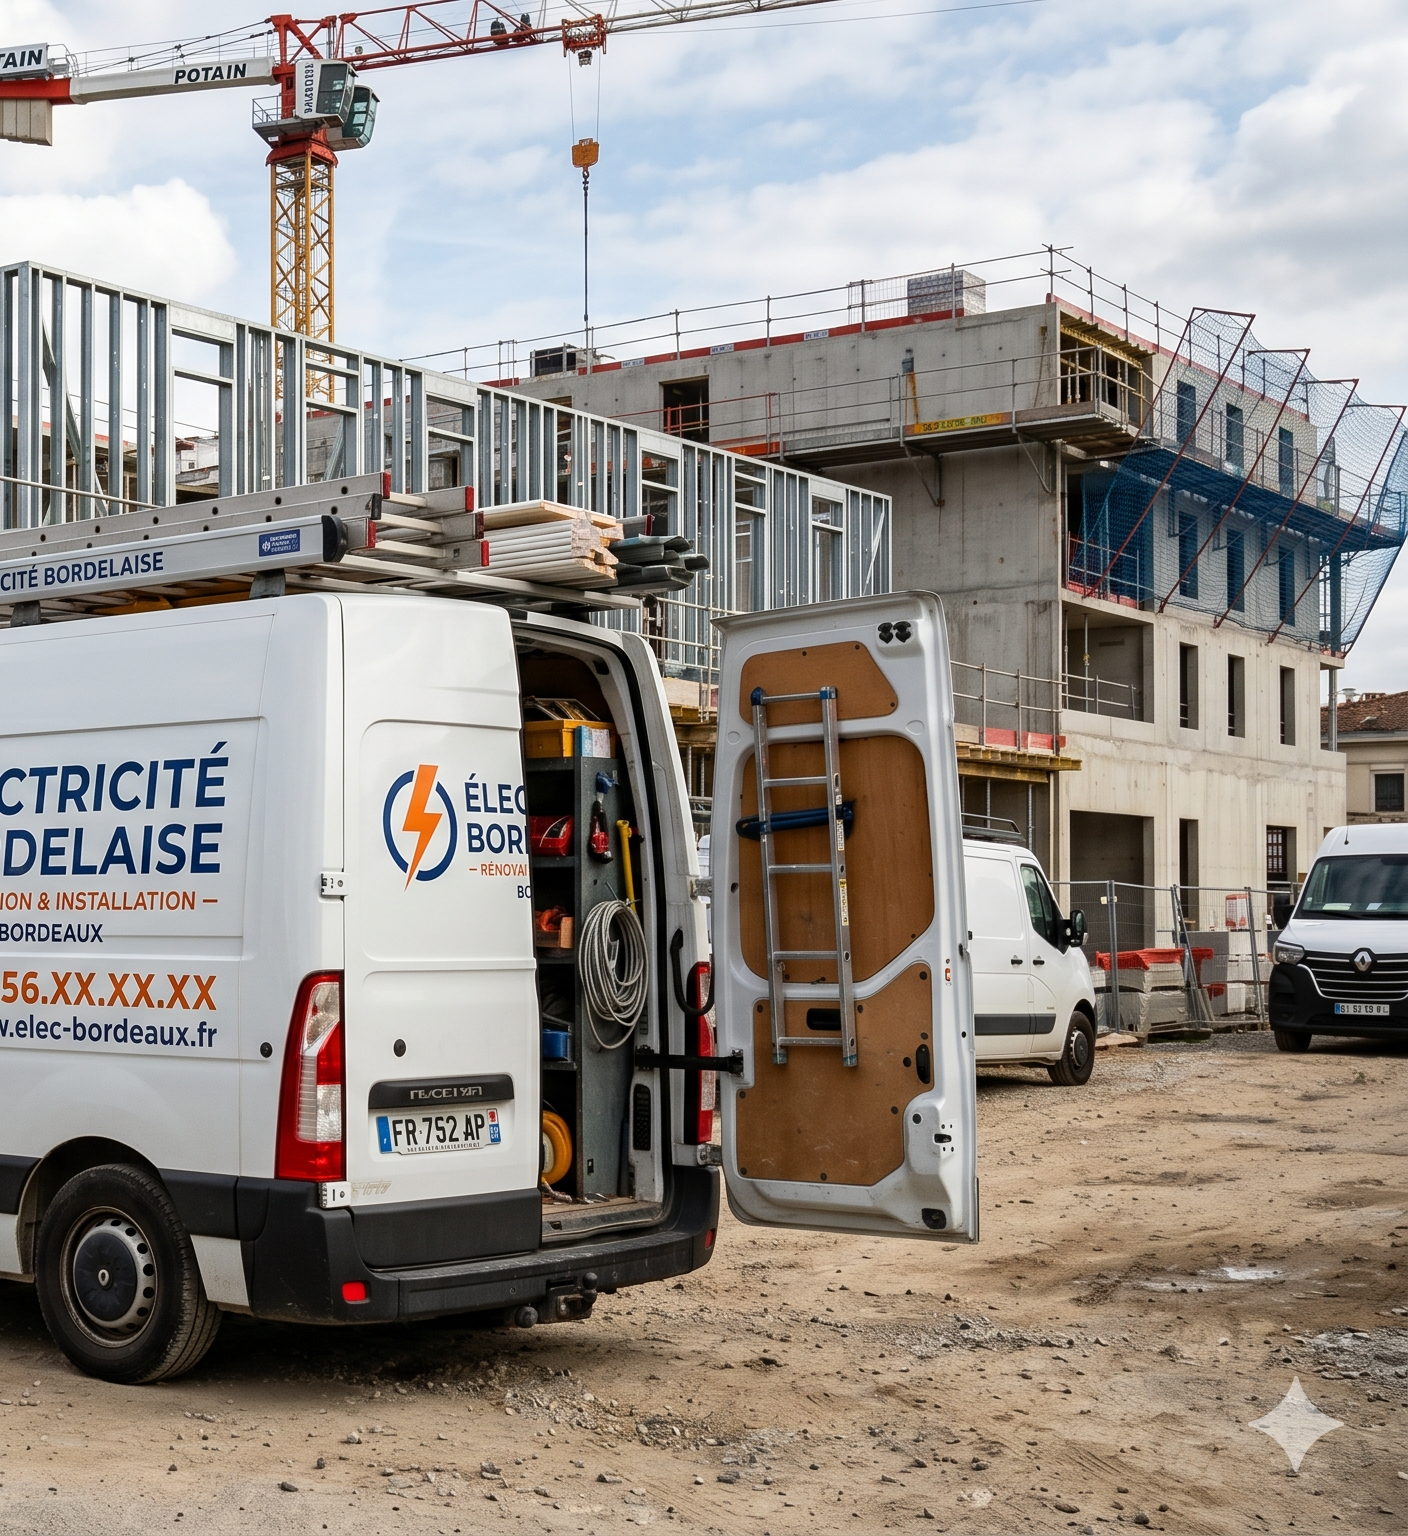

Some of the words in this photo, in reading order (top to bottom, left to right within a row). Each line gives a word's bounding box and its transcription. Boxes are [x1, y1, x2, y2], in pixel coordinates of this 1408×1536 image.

[174, 63, 247, 84] POTAIN
[44, 551, 164, 586] BORDELAISE
[467, 823, 529, 855] BOR
[37, 893, 51, 911] &
[56, 891, 196, 911] INSTALLATION
